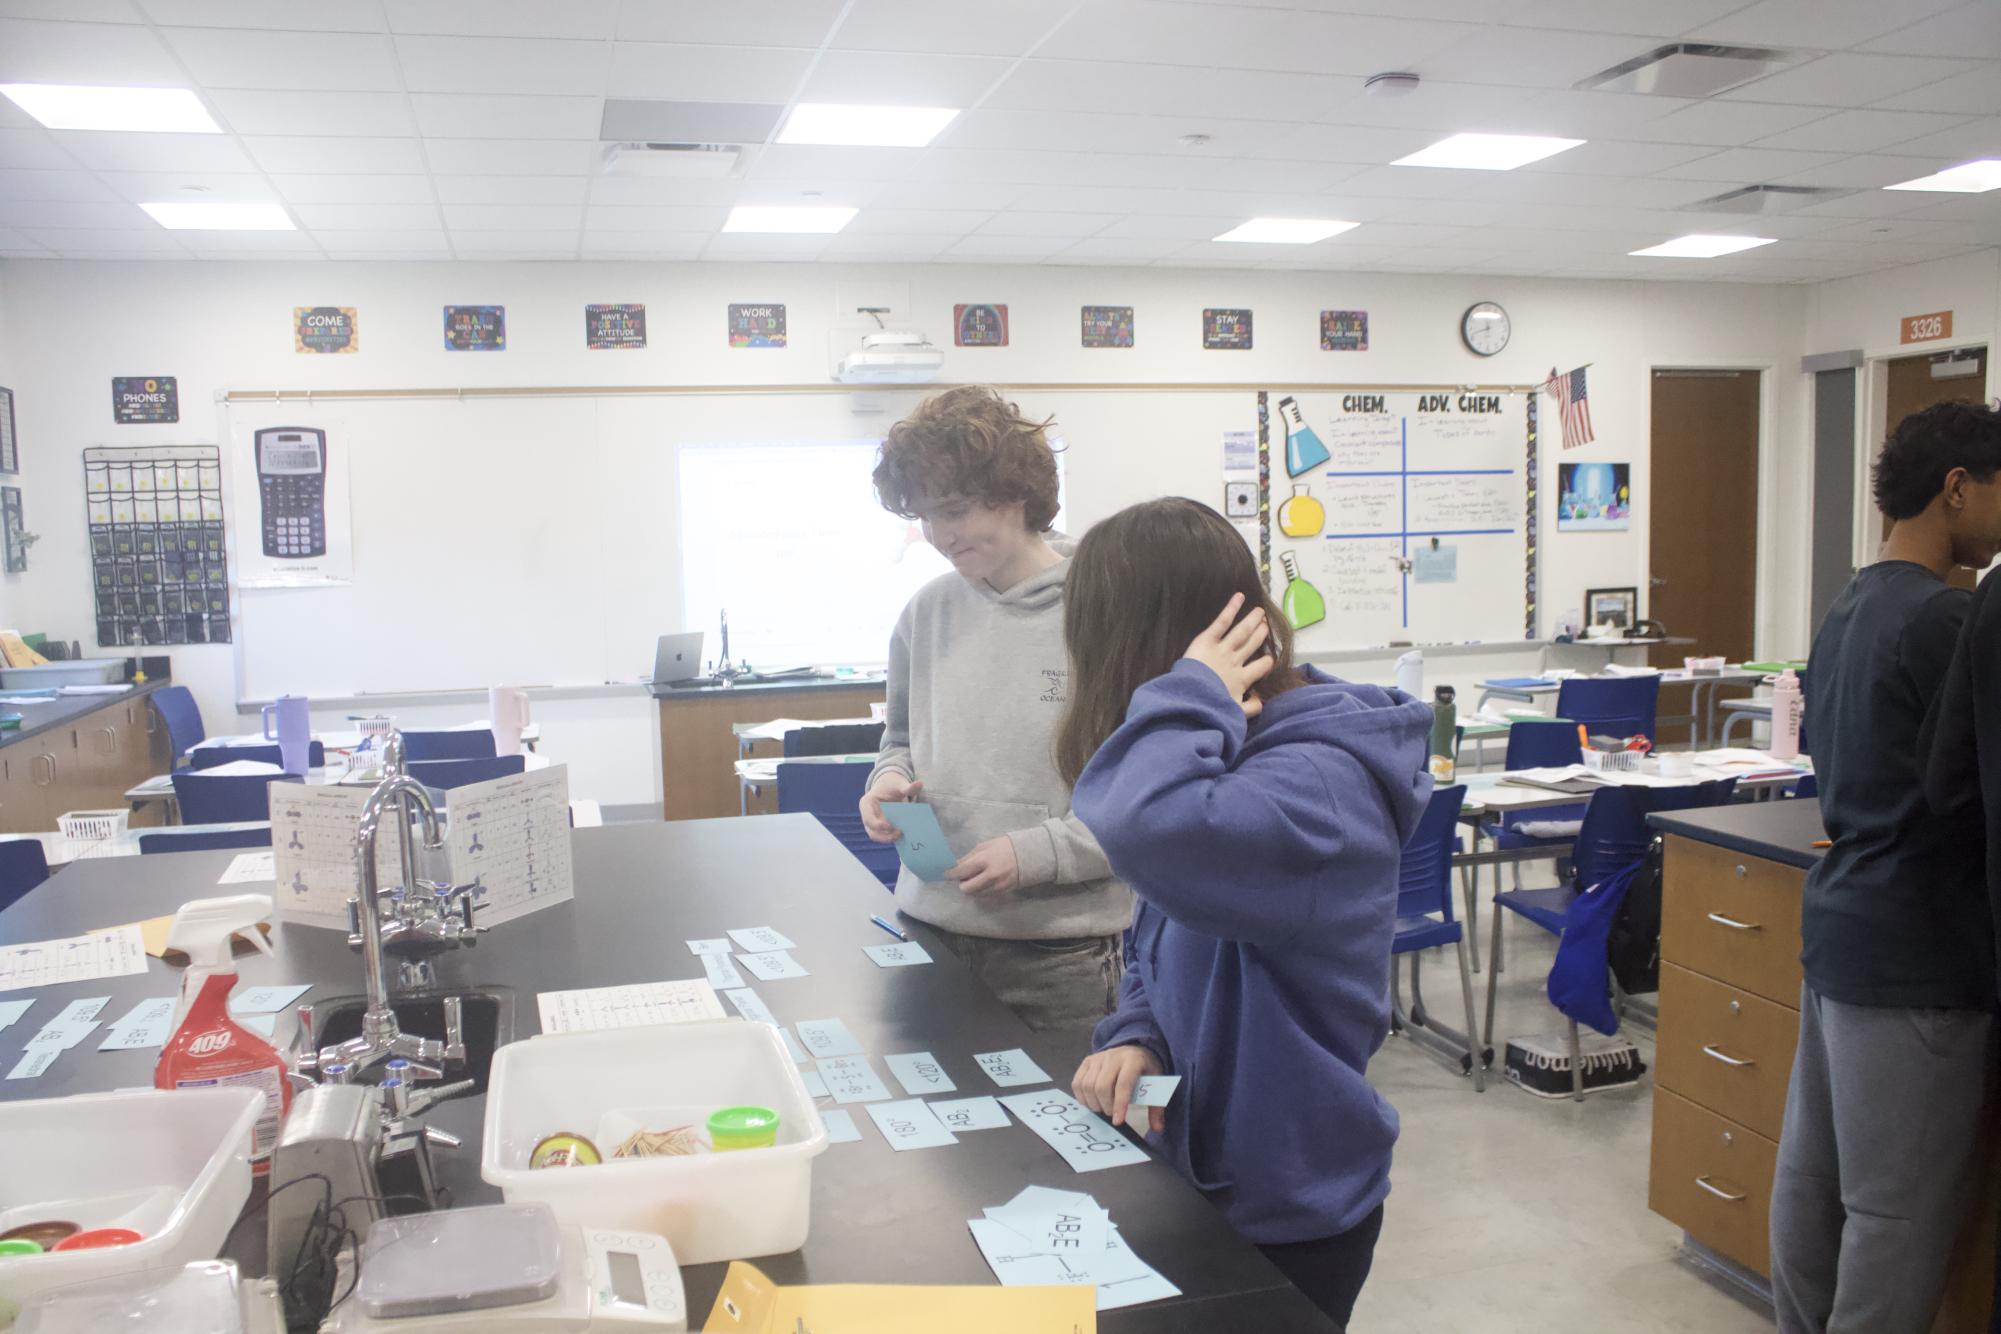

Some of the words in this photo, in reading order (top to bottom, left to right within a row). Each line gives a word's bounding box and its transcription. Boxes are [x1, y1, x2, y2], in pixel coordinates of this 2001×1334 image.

[741, 308, 772, 318] WORK
[307, 316, 344, 326] COME
[1216, 315, 1238, 324] STAY
[976, 324, 985, 332] TO
[1910, 316, 1942, 340] 3326
[123, 394, 167, 402] PHONES
[1342, 395, 1388, 414] CHEM.
[1418, 396, 1450, 412] ADV.
[1458, 396, 1502, 414] CHEM.
[1040, 694, 1066, 702] OCEAN
[188, 1031, 231, 1054] 409
